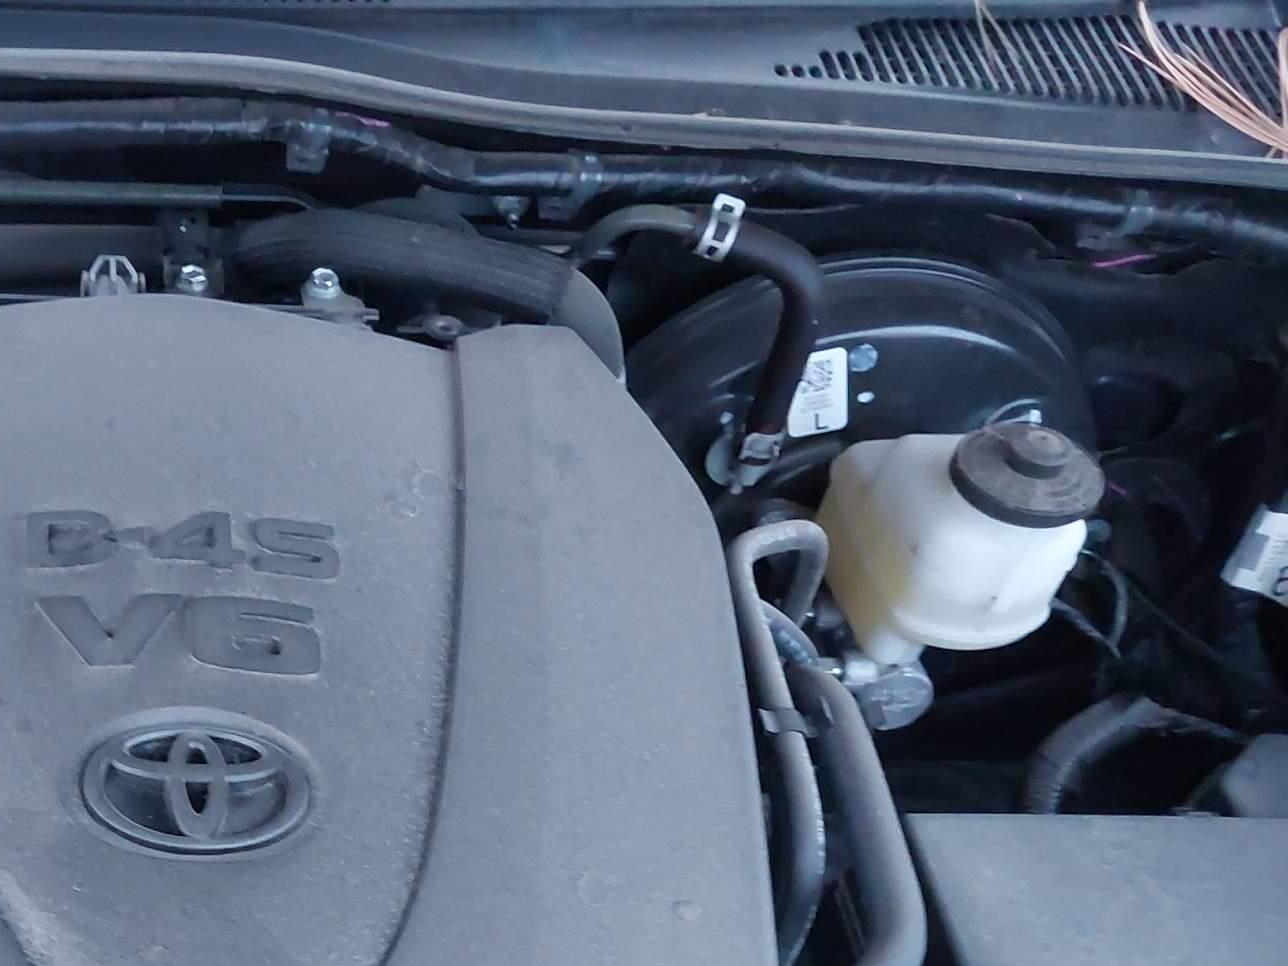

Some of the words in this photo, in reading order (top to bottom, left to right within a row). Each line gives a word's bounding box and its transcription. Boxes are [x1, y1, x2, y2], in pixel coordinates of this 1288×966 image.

[814, 413, 829, 430] L
[25, 510, 340, 580] D-4S
[34, 594, 322, 677] V6
